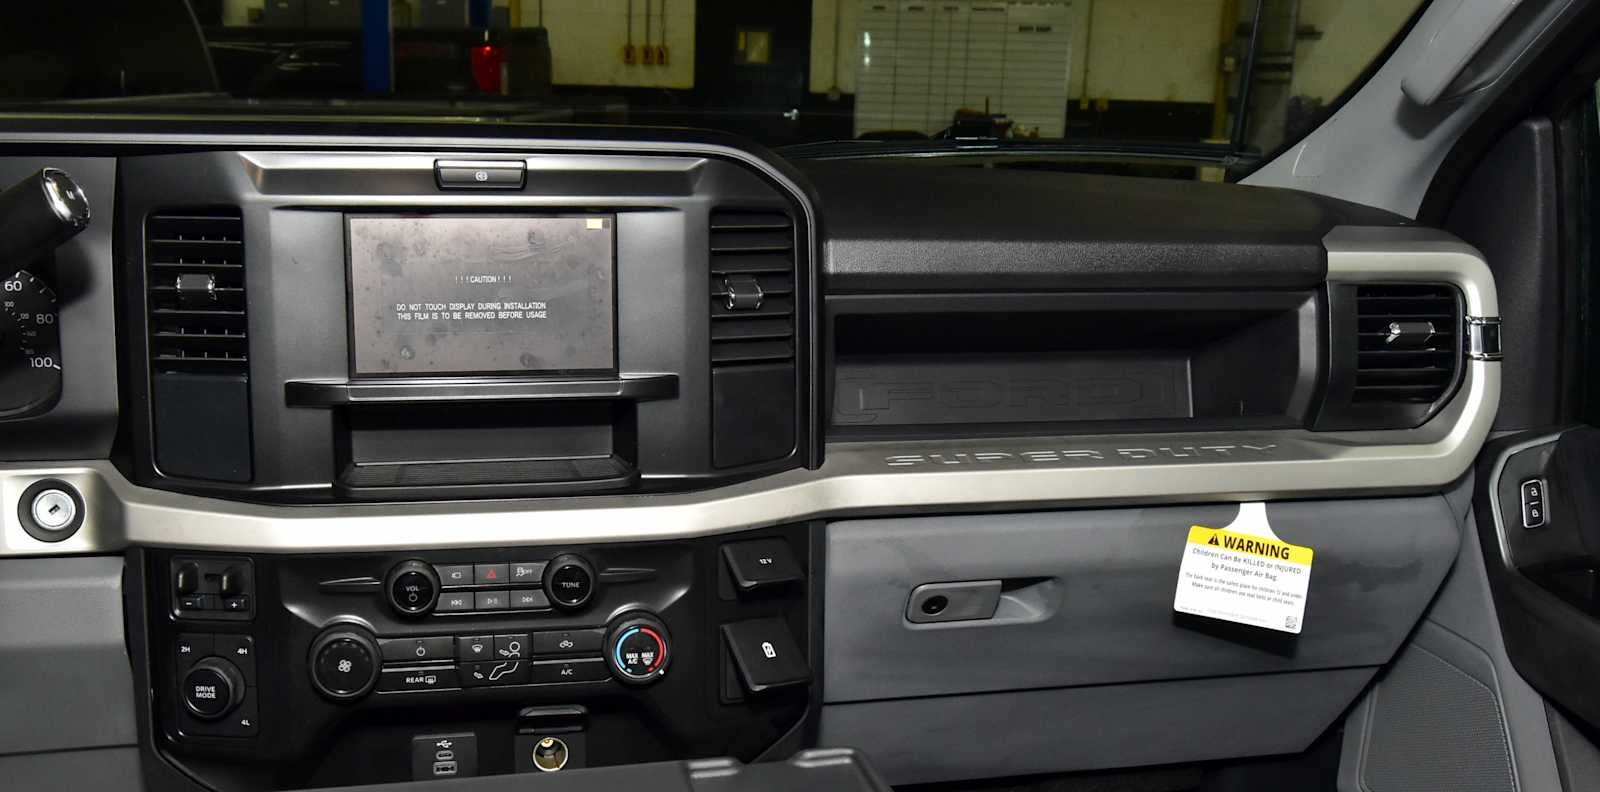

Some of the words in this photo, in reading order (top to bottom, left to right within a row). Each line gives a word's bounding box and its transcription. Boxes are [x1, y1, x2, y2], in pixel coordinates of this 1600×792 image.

[4, 281, 23, 292] 60
[396, 303, 406, 311] DO
[409, 303, 422, 311] NOT
[425, 303, 447, 311] TOUCH
[450, 303, 474, 311] DISPLAY
[35, 314, 54, 325] 80
[414, 312, 429, 320] FILM
[432, 312, 438, 320] IS
[441, 312, 450, 320] TO
[498, 311, 523, 319] BEFORE
[30, 357, 53, 368] 100
[885, 450, 1105, 466] SUPER
[1116, 444, 1277, 459] DUTY
[1225, 536, 1289, 559] WARNING
[1191, 547, 1220, 559] Children
[1219, 552, 1233, 561] Can
[1232, 555, 1242, 564] Be
[1242, 557, 1266, 568] KILLED
[1274, 563, 1302, 575] INJURED
[1211, 561, 1220, 571] by
[1219, 563, 1254, 577] Passenger
[1253, 570, 1265, 578] Air
[1264, 571, 1278, 583] Bag
[561, 581, 580, 589] TUNE
[180, 645, 191, 653] 2H
[237, 647, 248, 655] 4H
[625, 652, 639, 660] MAX
[641, 651, 654, 660] MAX
[626, 657, 638, 665] A/C
[560, 668, 573, 676] A/C
[405, 676, 425, 684] REAR
[195, 685, 216, 693] DRIVE
